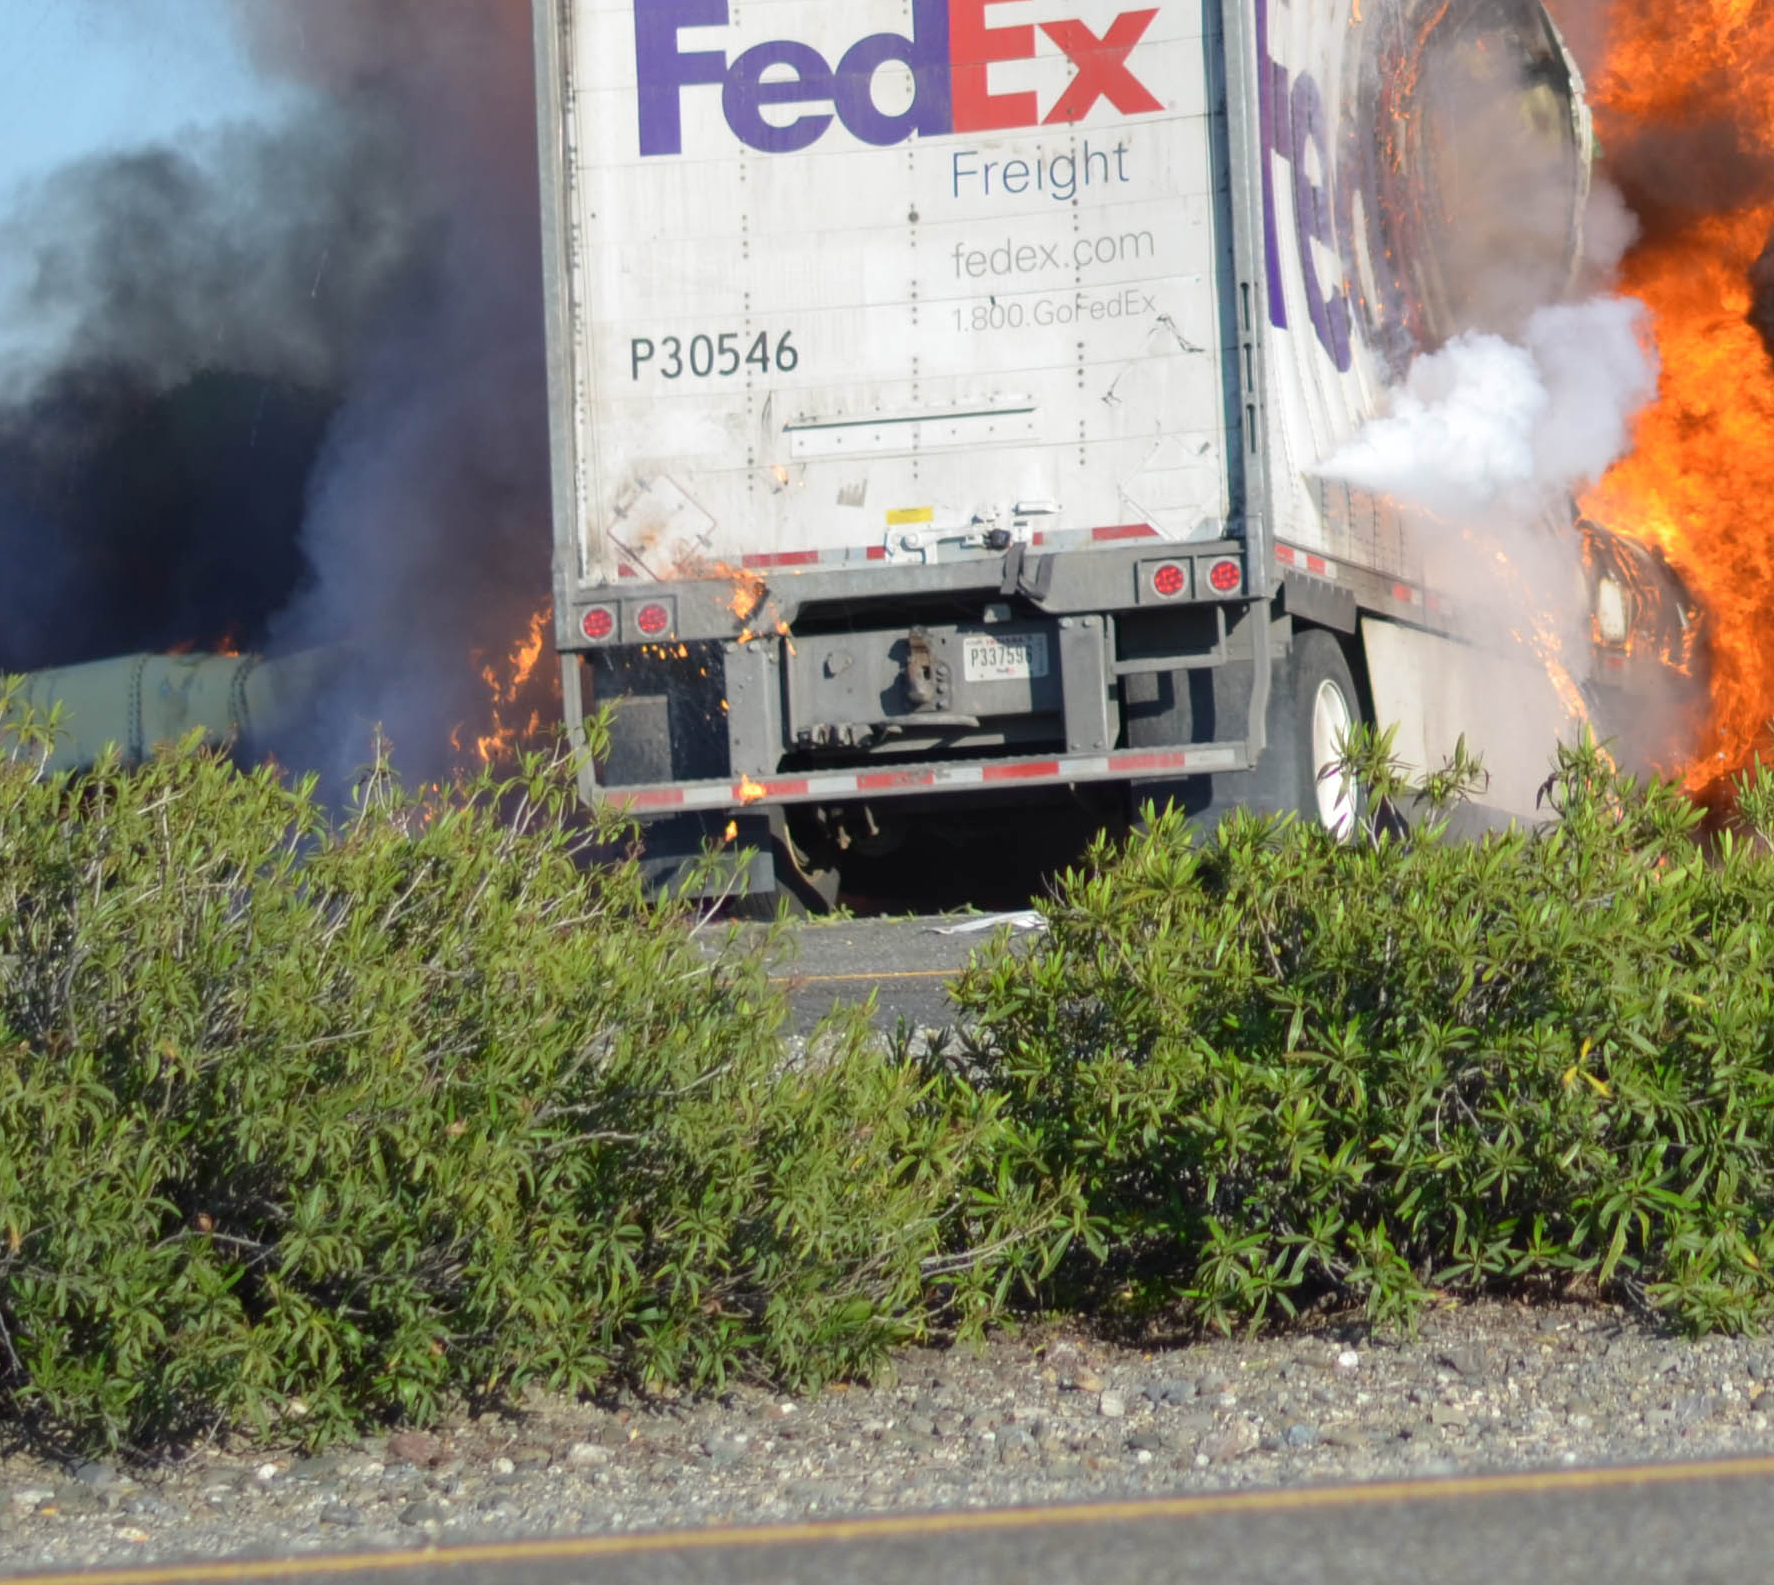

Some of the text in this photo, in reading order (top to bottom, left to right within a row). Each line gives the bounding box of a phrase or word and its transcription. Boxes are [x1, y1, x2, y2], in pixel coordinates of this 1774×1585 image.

[953, 140, 1130, 200] Freight
[952, 230, 1154, 279] fedex.com
[953, 289, 1157, 332] 1.800.GoFedEx
[631, 330, 799, 381] P30546
